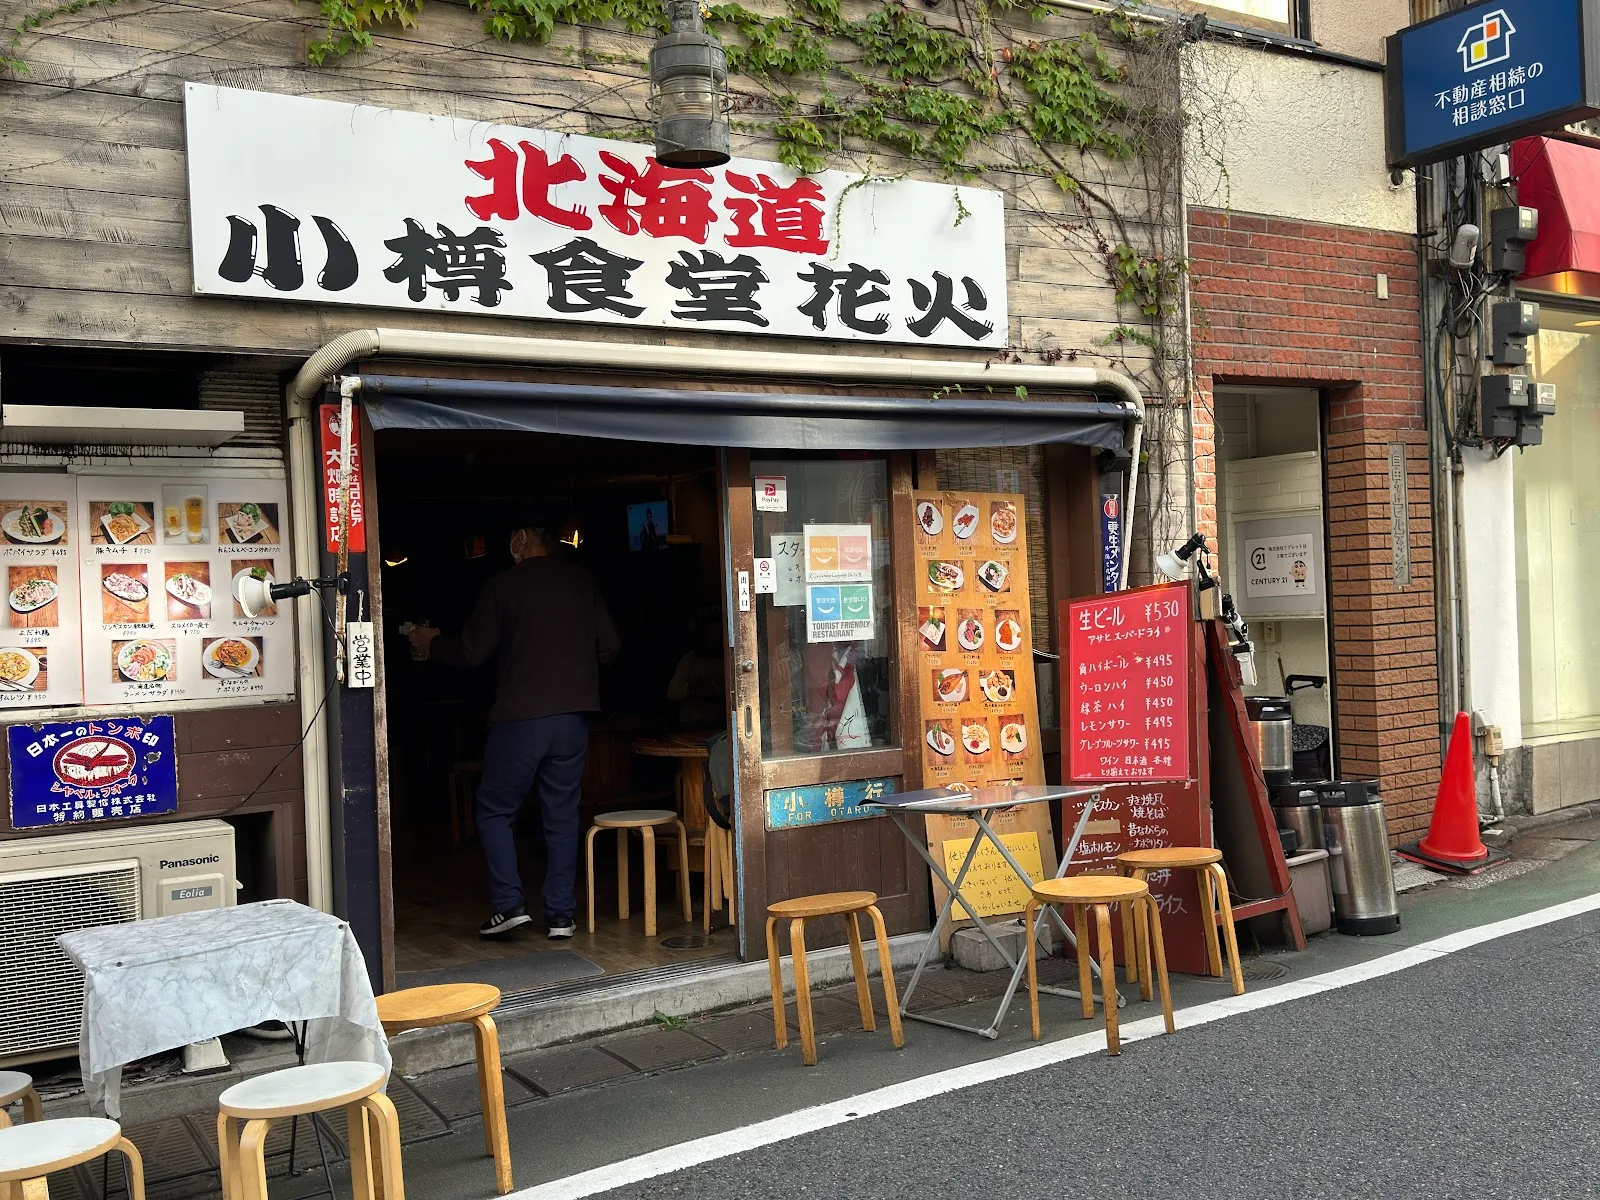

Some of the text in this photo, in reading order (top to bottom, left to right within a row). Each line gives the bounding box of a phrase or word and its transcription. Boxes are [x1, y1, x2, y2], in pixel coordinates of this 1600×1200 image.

[1434, 62, 1544, 110] 不動産相続の
[1452, 88, 1525, 127] 相談窓口
[465, 138, 831, 256] 北海道
[1251, 576, 1288, 585] CENTURY 21
[740, 576, 748, 606] 出入口
[1079, 600, 1179, 631] 生ビール ¥530
[813, 620, 870, 631] TOURIST FRIENDLY
[812, 630, 854, 639] RESTAURANT
[1088, 626, 1160, 645] アサヒ スーパードライ
[352, 634, 372, 685] 営業中
[1079, 653, 1173, 676] 角ハイボール ¥495
[1079, 676, 1174, 694] ウーロンハイ ¥450
[1145, 697, 1174, 711] ¥450
[1081, 717, 1173, 732] レモンサワー ¥495
[26, 722, 159, 757] 日本一のトンボ印
[1079, 737, 1171, 752] グレープフルーツサワー ¥495
[1100, 755, 1172, 767] ワイン 日本酒 各種
[788, 806, 870, 822] FOR OTARU
[1127, 822, 1168, 837] 昔ながらの
[1078, 839, 1121, 855] 塩ホルモン
[159, 854, 220, 870] Panasonic
[179, 888, 205, 899] Eolia
